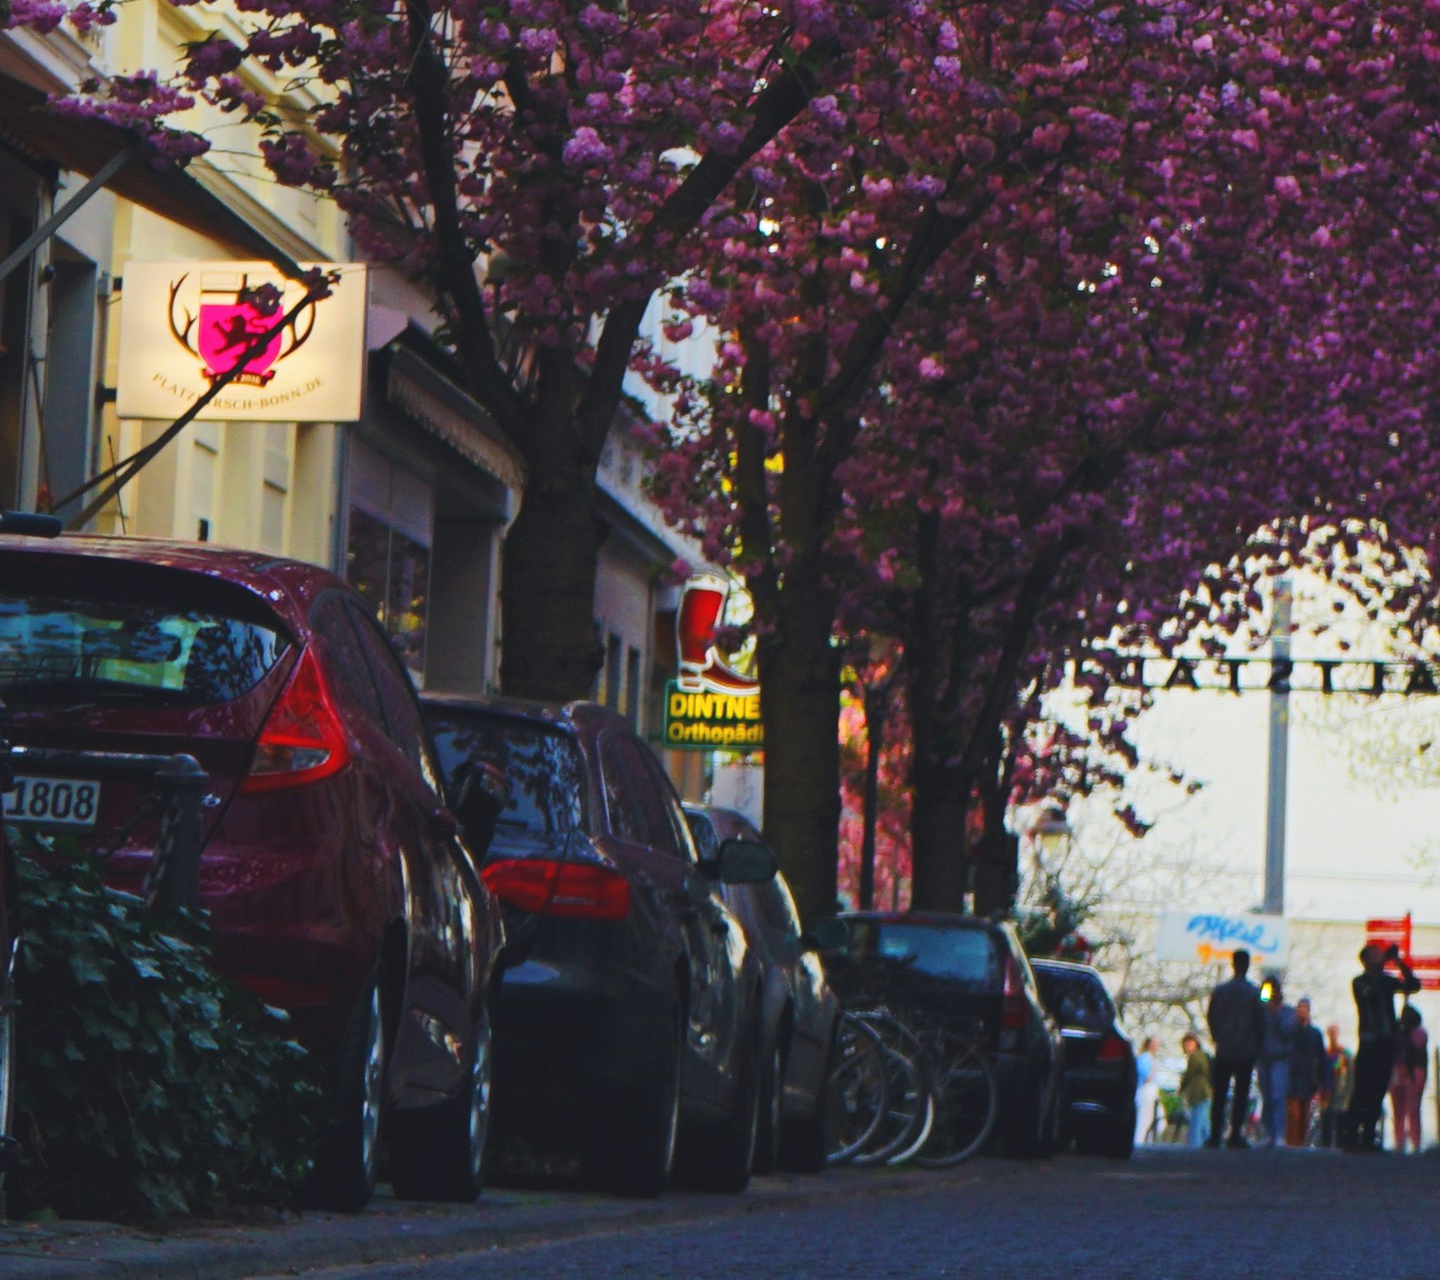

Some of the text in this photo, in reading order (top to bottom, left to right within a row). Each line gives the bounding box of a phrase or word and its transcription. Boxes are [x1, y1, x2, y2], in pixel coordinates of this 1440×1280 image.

[152, 372, 326, 410] PLATZRSCH-BONN.DE
[669, 693, 762, 720] DINTNE
[667, 721, 765, 745] Orthopädi
[4, 779, 95, 822] 1808
